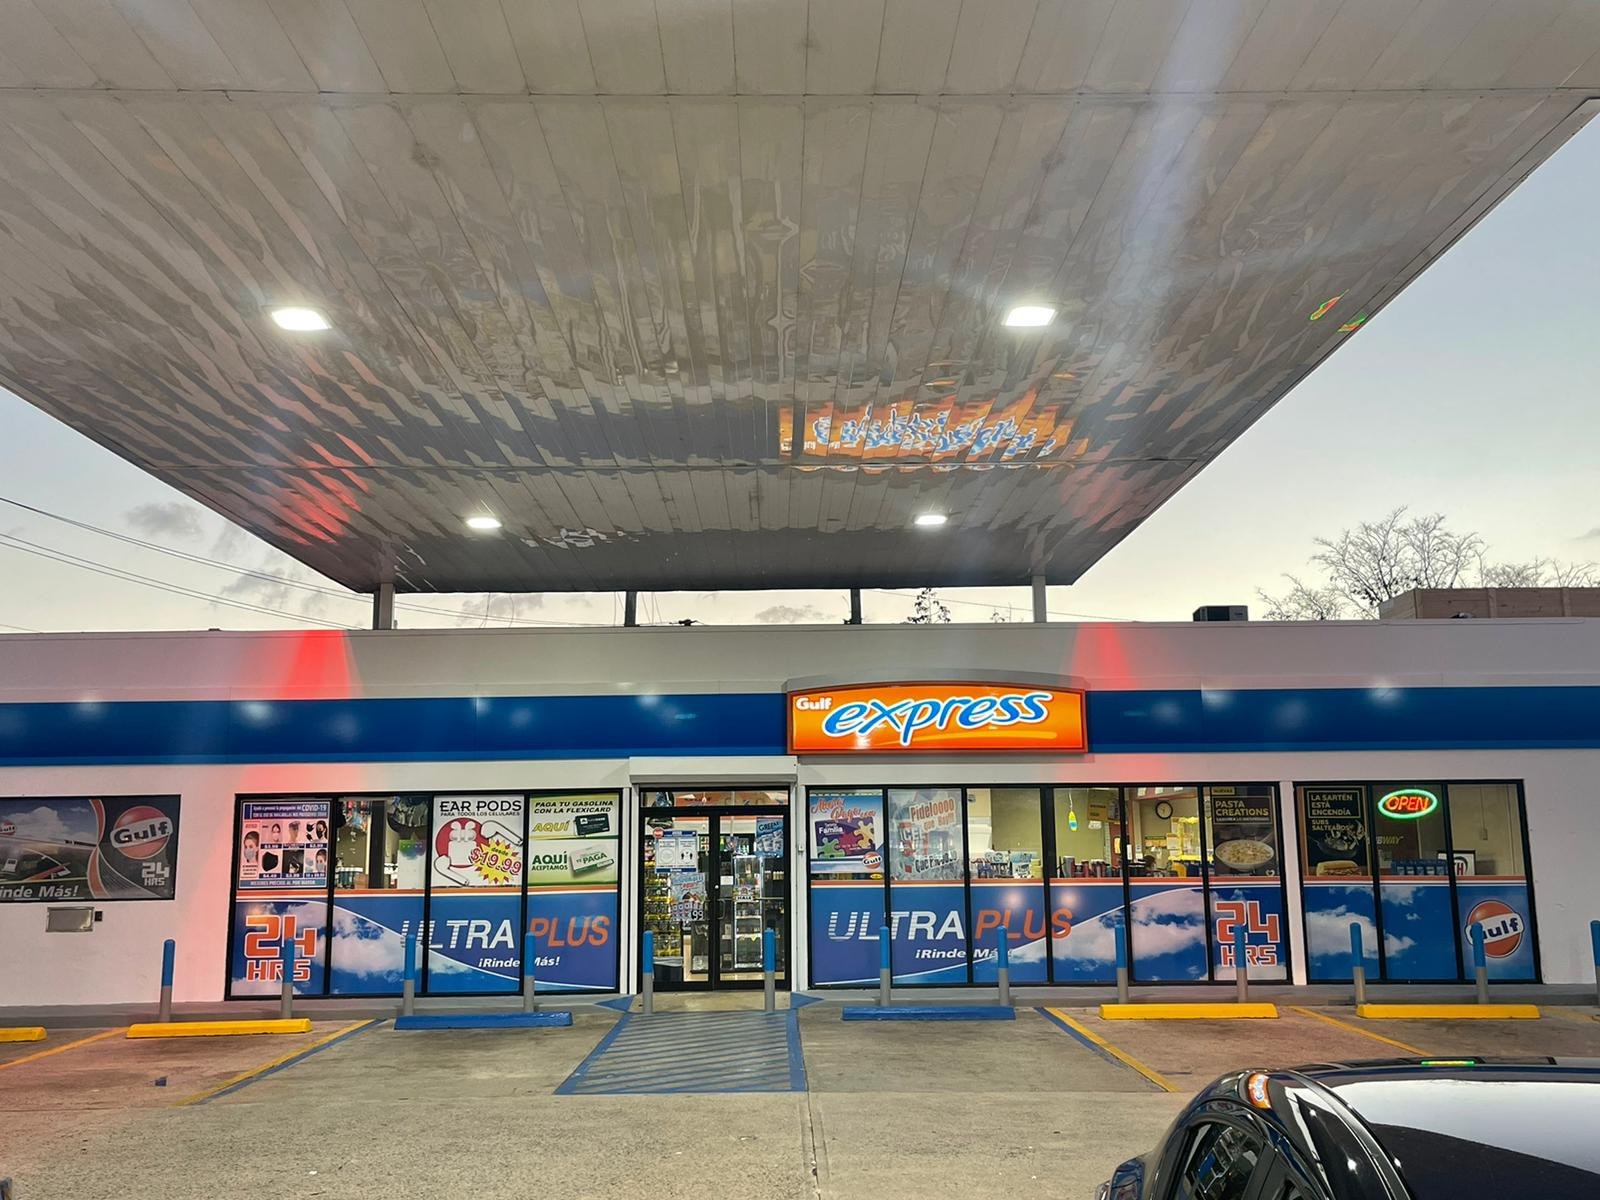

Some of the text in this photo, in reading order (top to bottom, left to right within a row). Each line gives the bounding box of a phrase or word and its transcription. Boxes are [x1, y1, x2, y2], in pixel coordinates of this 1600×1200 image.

[795, 696, 832, 711] Gulf
[822, 691, 1053, 746] express
[302, 804, 327, 812] COVID-19
[440, 800, 522, 812] EAR PODS
[1386, 796, 1429, 811] OPEN
[1216, 808, 1269, 816] CREATIONS
[115, 821, 169, 844] Gulf
[532, 820, 570, 832] AQUÍ
[469, 848, 522, 875] $19.99
[532, 851, 568, 865] AQUÍ
[583, 852, 607, 864] PAGA
[863, 857, 881, 865] Gulf
[142, 862, 169, 878] 24
[144, 877, 165, 886] HRS
[39, 885, 79, 898] Más!
[828, 908, 1073, 941] ULTRA PLUS
[1215, 901, 1281, 944] 24
[244, 915, 318, 959] 24
[529, 915, 611, 948] PLUS
[915, 948, 967, 959] ¡Rinde
[1220, 944, 1277, 967] HRS
[247, 959, 311, 982] HRS
[478, 958, 520, 969] ¡Rinde
